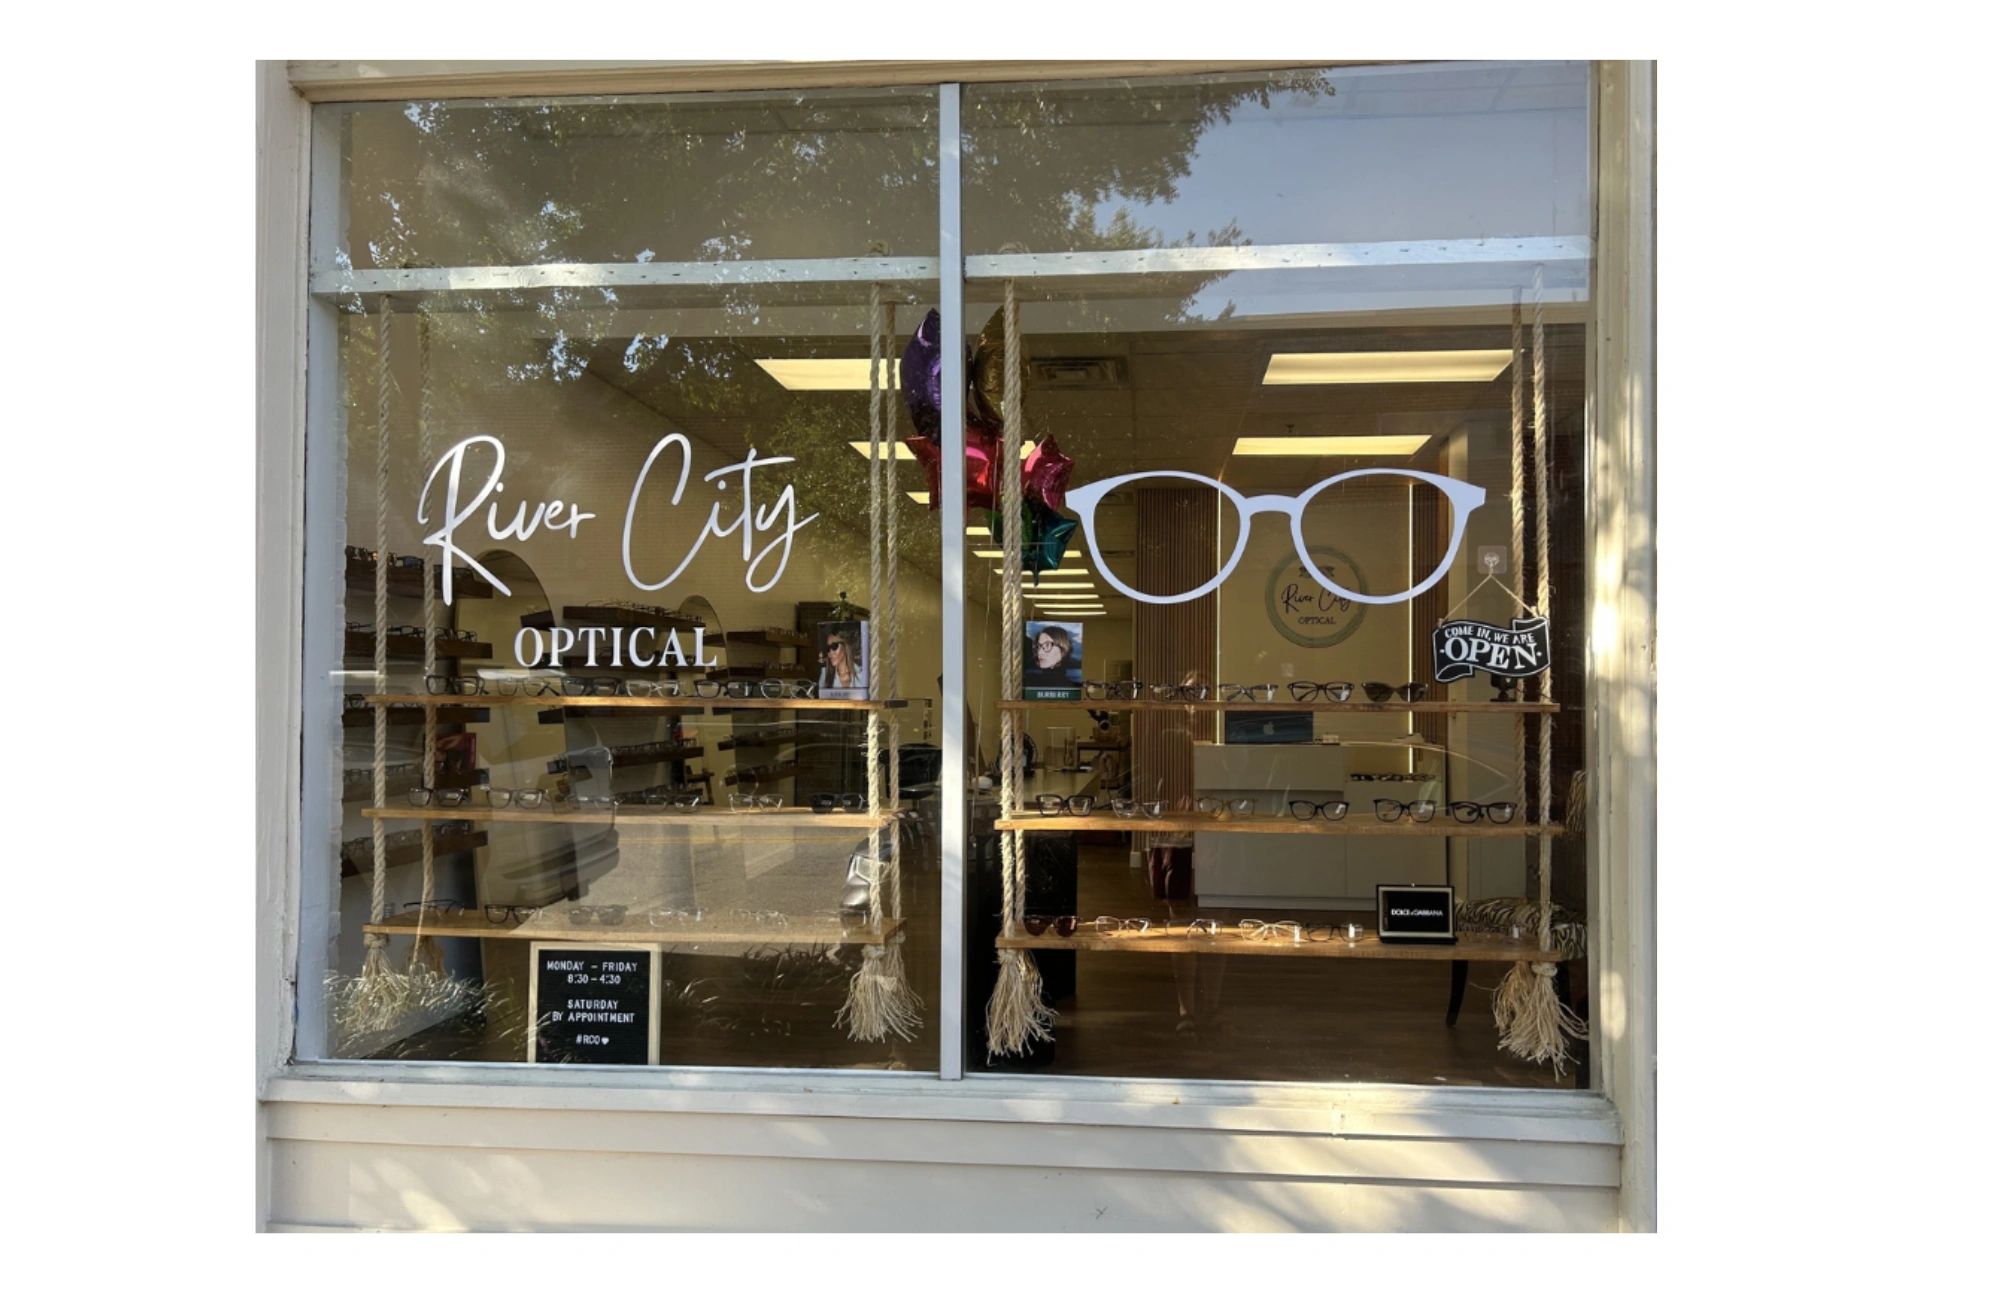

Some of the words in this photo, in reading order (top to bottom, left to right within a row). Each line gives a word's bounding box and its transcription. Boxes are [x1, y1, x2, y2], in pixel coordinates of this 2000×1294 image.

[418, 434, 596, 607] River
[622, 433, 820, 593] City
[1281, 583, 1314, 614] River
[1298, 616, 1337, 625] OPTICAL
[1444, 626, 1474, 638] COME
[1477, 627, 1491, 641] IN,
[1494, 633, 1509, 644] WE
[1512, 633, 1535, 644] ARE
[514, 626, 718, 668] OPTICAL
[1444, 637, 1537, 669] OPEN
[546, 960, 585, 971] MONDAY
[602, 962, 638, 972] FRIDAY
[567, 973, 589, 984] 8:30
[599, 974, 621, 985] 4:30
[567, 999, 619, 1010] SATURDAY
[552, 1011, 564, 1021] BY
[568, 1012, 635, 1023] APPOINTMENT
